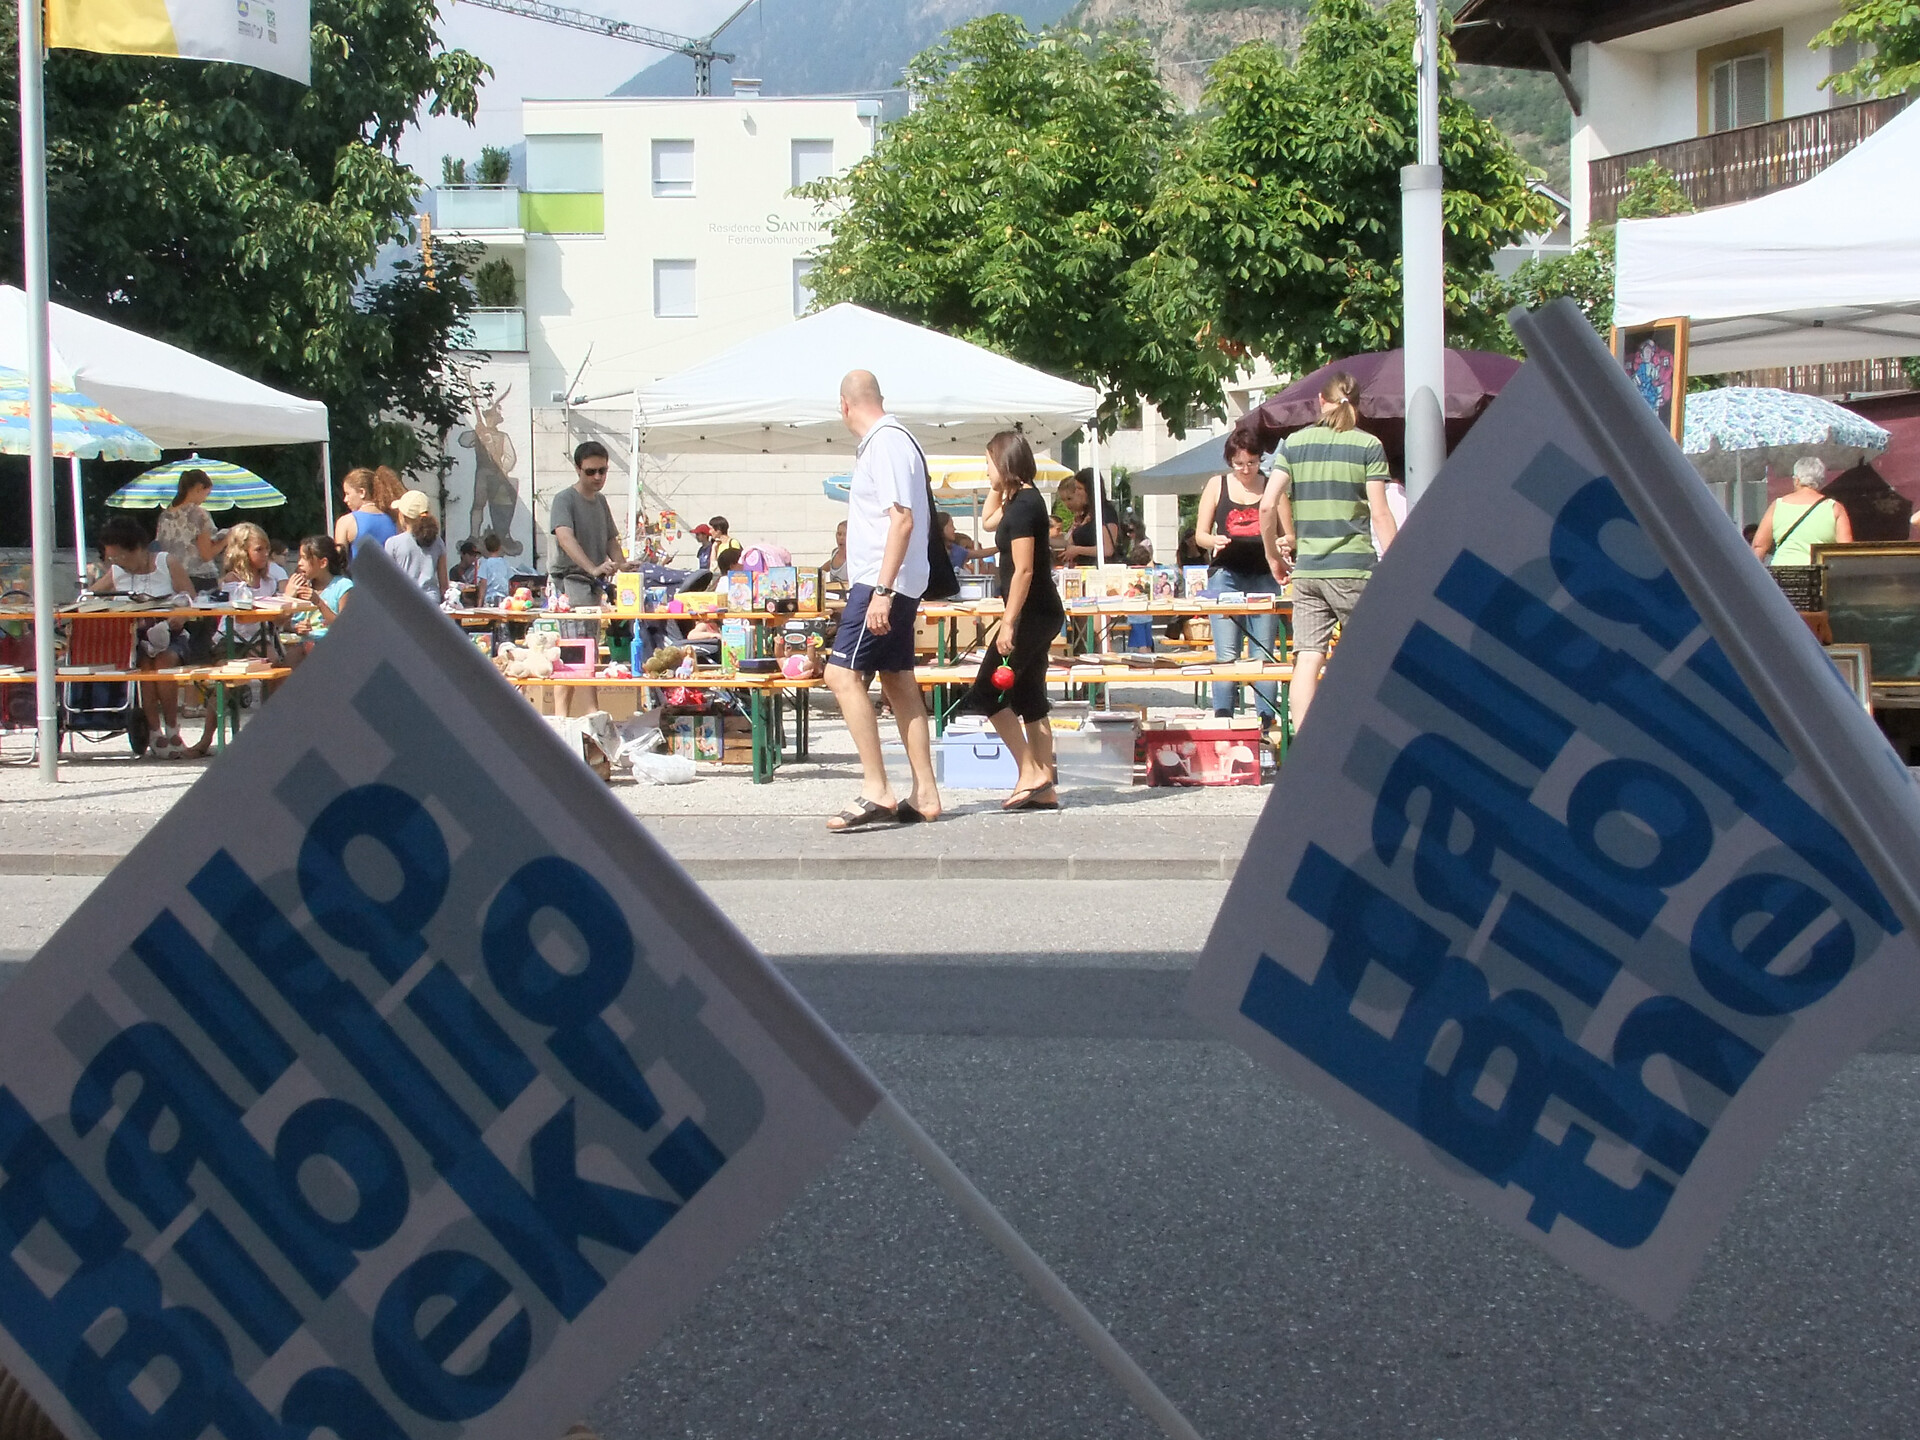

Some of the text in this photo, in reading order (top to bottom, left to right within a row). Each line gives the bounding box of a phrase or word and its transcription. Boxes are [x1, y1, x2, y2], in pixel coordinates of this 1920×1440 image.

[709, 223, 761, 233] Residence
[728, 235, 816, 246] Ferienwohnungen
[1385, 592, 1792, 1188] Bibli
[25, 855, 634, 1440] Biblio
